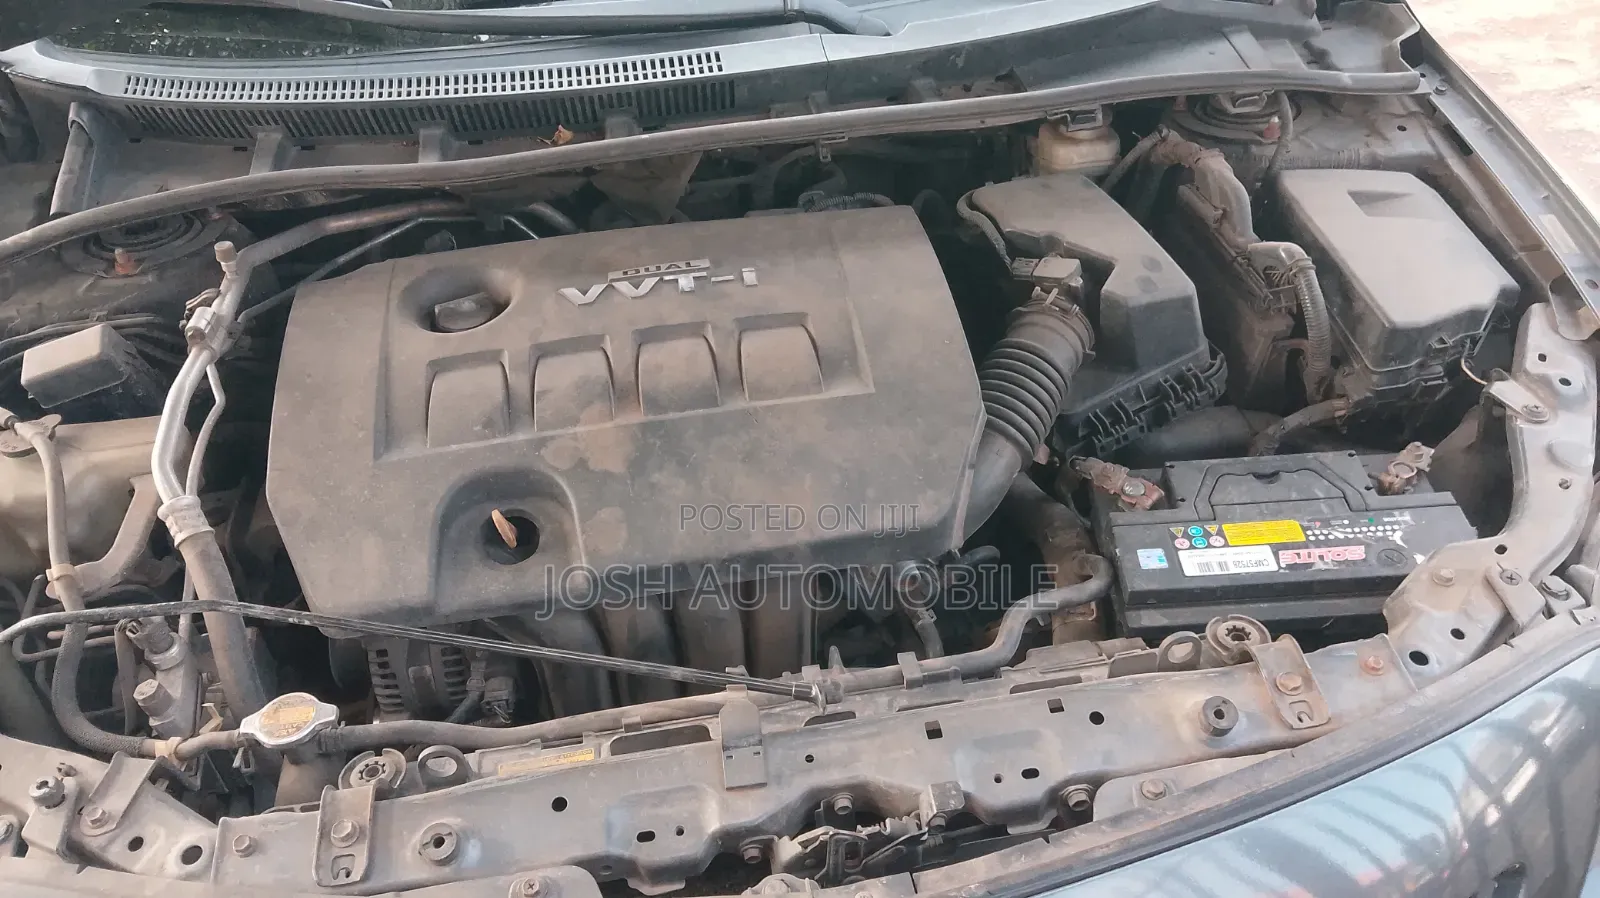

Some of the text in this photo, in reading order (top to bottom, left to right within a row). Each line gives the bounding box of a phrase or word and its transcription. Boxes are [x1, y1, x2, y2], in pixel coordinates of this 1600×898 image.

[622, 260, 702, 276] DUAL
[557, 267, 759, 306] VVT-i
[1278, 545, 1366, 564] SOLITE
